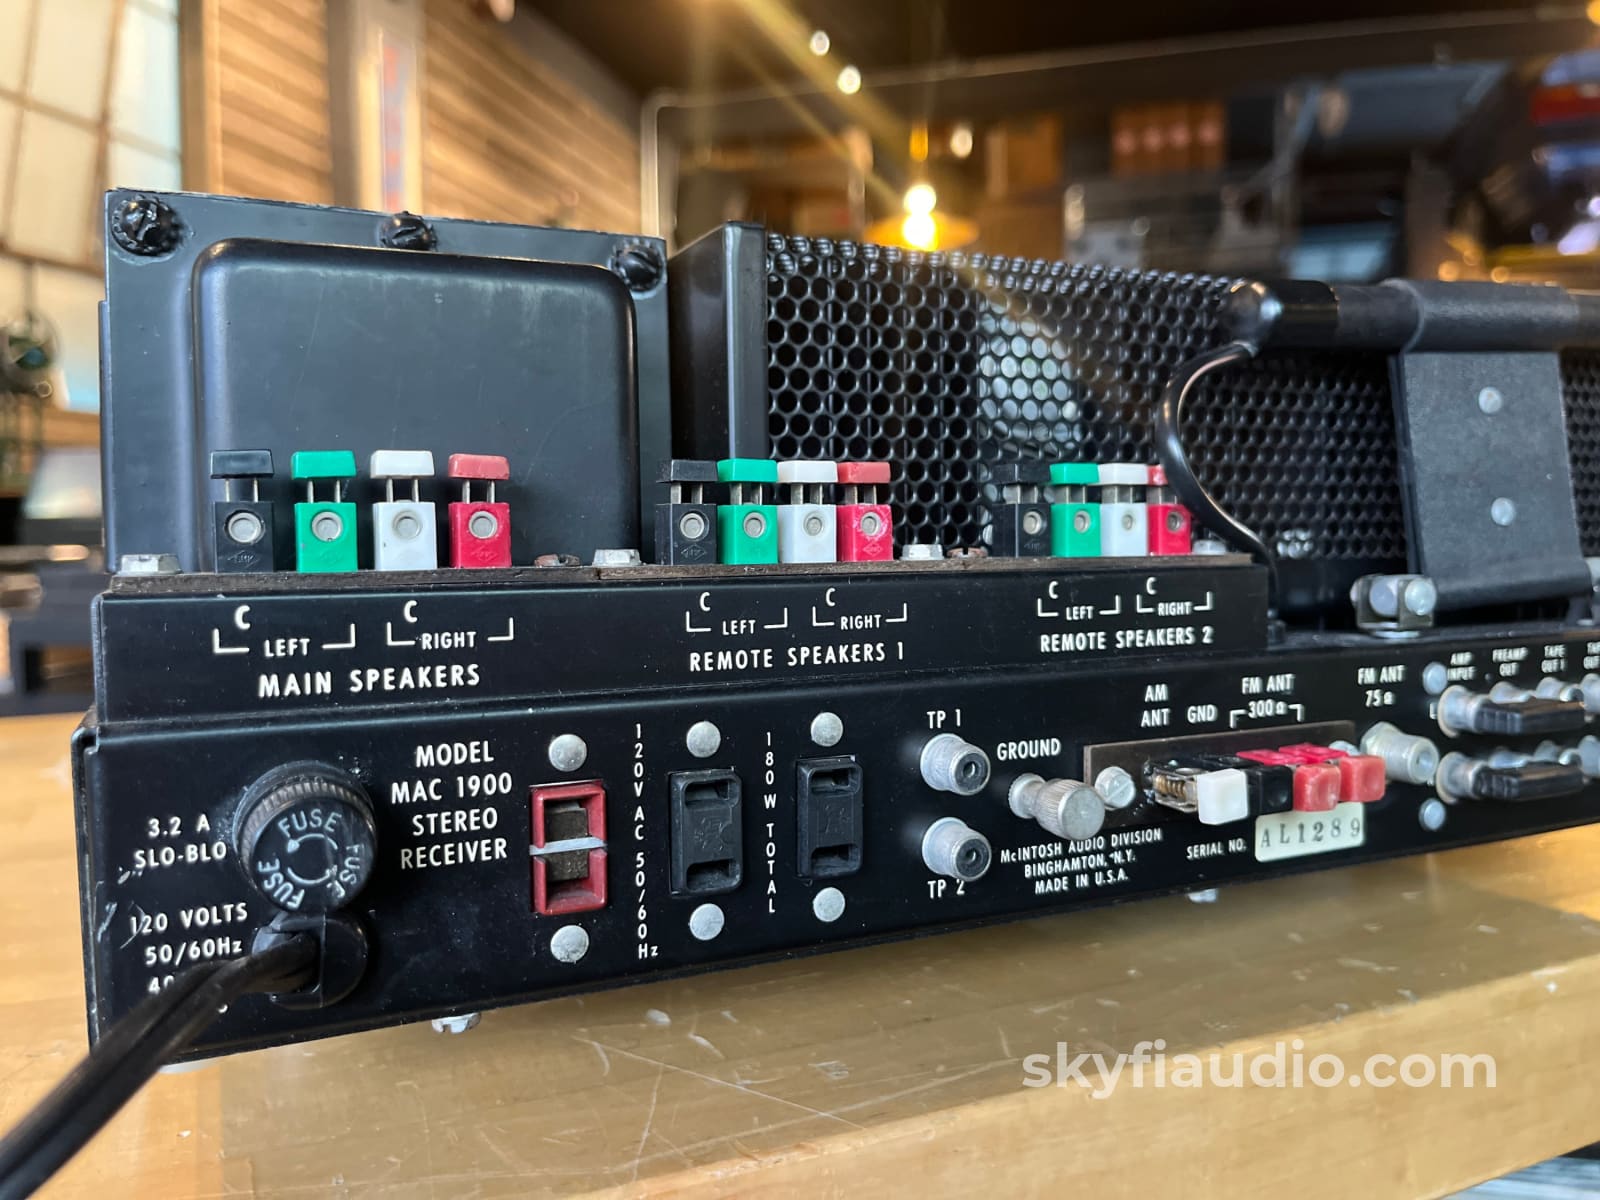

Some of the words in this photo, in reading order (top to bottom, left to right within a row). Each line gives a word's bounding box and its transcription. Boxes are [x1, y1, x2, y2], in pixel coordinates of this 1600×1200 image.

[1049, 581, 1058, 599] C
[1146, 577, 1155, 594] C
[700, 592, 710, 611] C
[826, 588, 835, 606] C
[235, 605, 250, 629] C
[404, 600, 417, 622] C
[1066, 606, 1093, 620] LEFT
[1158, 602, 1191, 616] RIGHT
[723, 620, 755, 635] LEFT
[841, 615, 881, 630] RIGHT
[264, 639, 309, 657] LEFT
[421, 631, 477, 650] RIGHT
[1041, 632, 1105, 652] REMOTE
[1116, 627, 1194, 648] SPEAKERS
[1203, 626, 1212, 643] 2
[690, 649, 772, 671] REMOTE
[788, 643, 885, 666] SPEAKERS
[898, 642, 903, 659] 1
[1450, 652, 1473, 666] AMP
[1544, 645, 1566, 658] TAPE
[1358, 668, 1376, 684] FM
[1380, 665, 1404, 682] ANT
[1447, 666, 1475, 680] INPUT
[1499, 662, 1518, 677] OUT
[259, 672, 331, 697] MAIN
[350, 664, 479, 692] SPEAKERS
[1242, 677, 1262, 694] FM
[1267, 674, 1294, 691] ANT
[1145, 684, 1167, 702] AM
[927, 711, 946, 728] TP
[956, 709, 960, 726] 1
[1141, 708, 1169, 727] ANT
[1187, 705, 1217, 723] GND
[415, 741, 494, 767] MODEL
[997, 738, 1061, 760] GROUND
[391, 779, 442, 804] MAC
[457, 772, 512, 797] 1900
[149, 817, 181, 837] 3.2
[197, 814, 210, 832] A
[278, 806, 344, 840] FUSE
[413, 807, 498, 837] STEREO
[1261, 818, 1360, 848] AL1289
[134, 841, 227, 869] SLO-BLO
[402, 838, 507, 868] RECEIVER
[1000, 841, 1063, 864] McINTOSH
[1068, 837, 1105, 854] AUDIO
[1110, 827, 1163, 847] DIVISION
[1187, 842, 1223, 859] SERIAL
[1229, 838, 1246, 852] NO.
[766, 823, 776, 913] TOTAL
[256, 857, 306, 911] FUSE
[928, 879, 946, 898] TP
[956, 878, 965, 895] 2
[1035, 876, 1069, 895] MADE
[1076, 874, 1088, 887] IN
[1095, 868, 1129, 886] U.S.A.
[130, 912, 168, 936] 120
[180, 901, 248, 929] VOLTS
[144, 936, 243, 966] 50/60Hz
